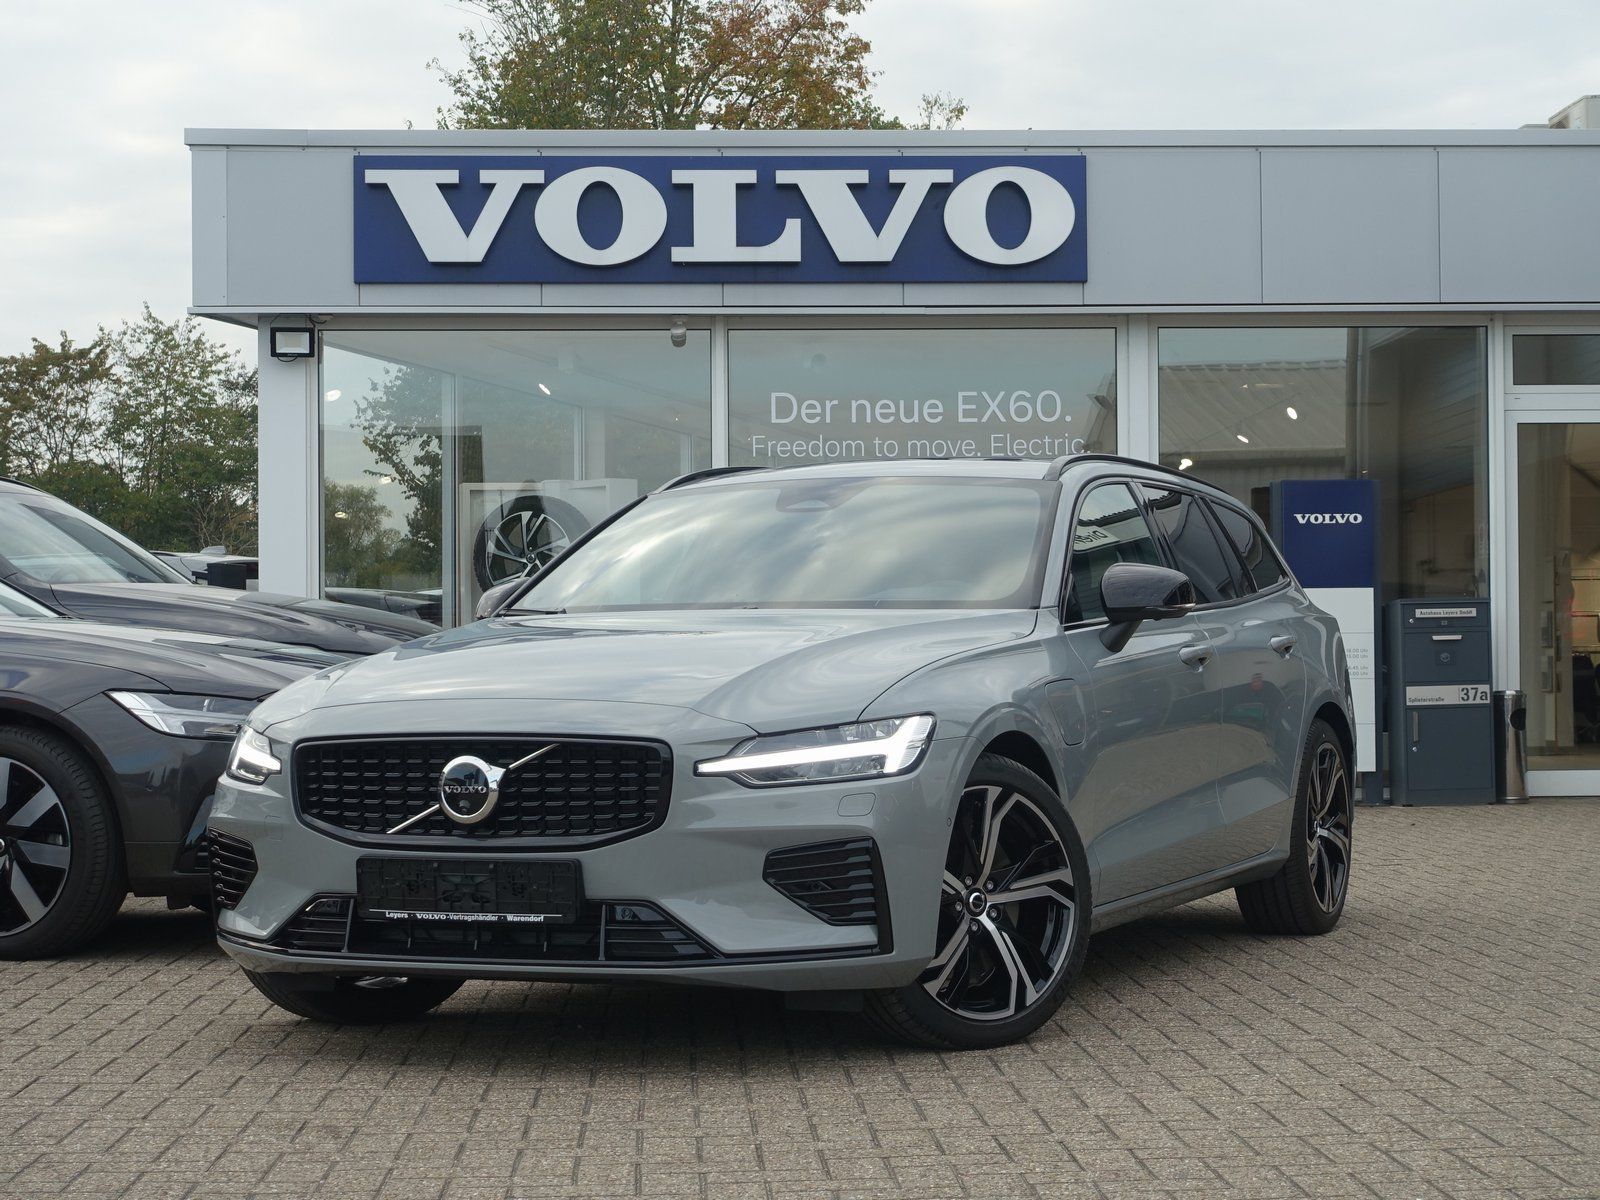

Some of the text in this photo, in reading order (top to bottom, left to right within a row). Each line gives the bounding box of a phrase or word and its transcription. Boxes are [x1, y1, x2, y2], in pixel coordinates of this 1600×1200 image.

[365, 165, 1076, 266] VOLVO
[770, 389, 1073, 424] Der neue EX60.
[751, 434, 866, 458] Freedom
[874, 437, 899, 457] to
[907, 438, 981, 458] move.
[1293, 513, 1363, 524] VOLVO
[1460, 687, 1488, 702] 37a
[443, 785, 487, 794] VOLVO
[385, 911, 409, 919] Leyers
